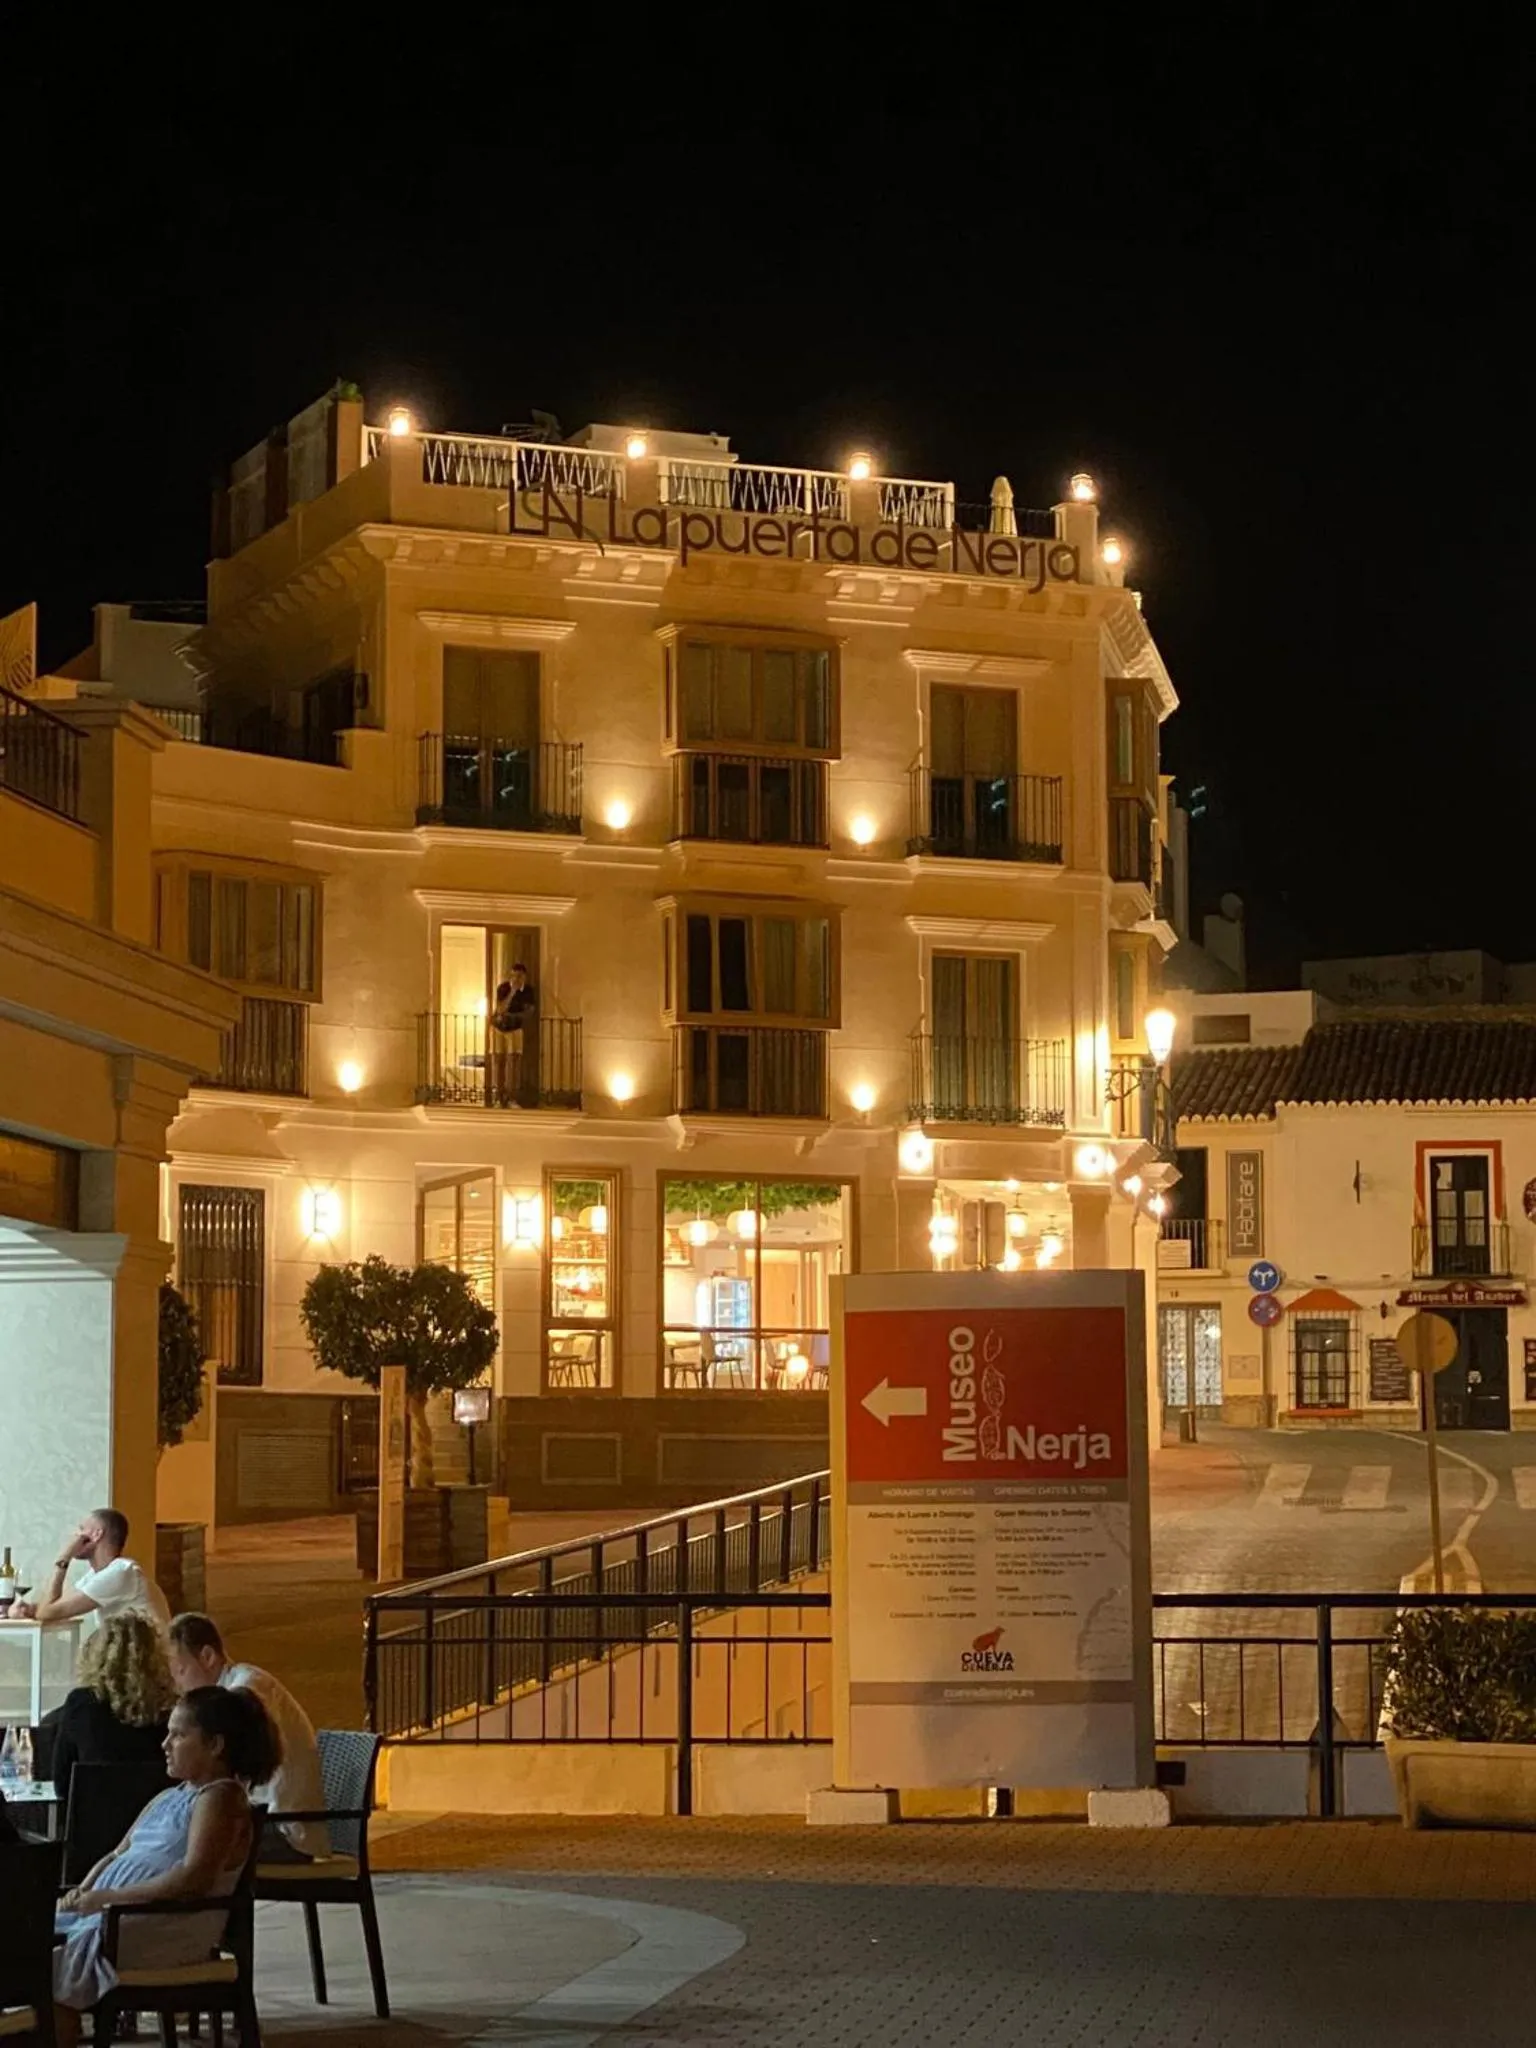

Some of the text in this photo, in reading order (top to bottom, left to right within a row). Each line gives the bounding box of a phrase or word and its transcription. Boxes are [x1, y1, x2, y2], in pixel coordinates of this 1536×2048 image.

[607, 486, 668, 548] La
[680, 502, 861, 568] puerta
[870, 512, 939, 570] de
[951, 520, 1080, 595] Nerja
[1236, 1160, 1255, 1248] Habitare
[942, 1325, 977, 1462] Museo
[1006, 1424, 1112, 1469] Nerja
[961, 1651, 1014, 1664] CUEVA
